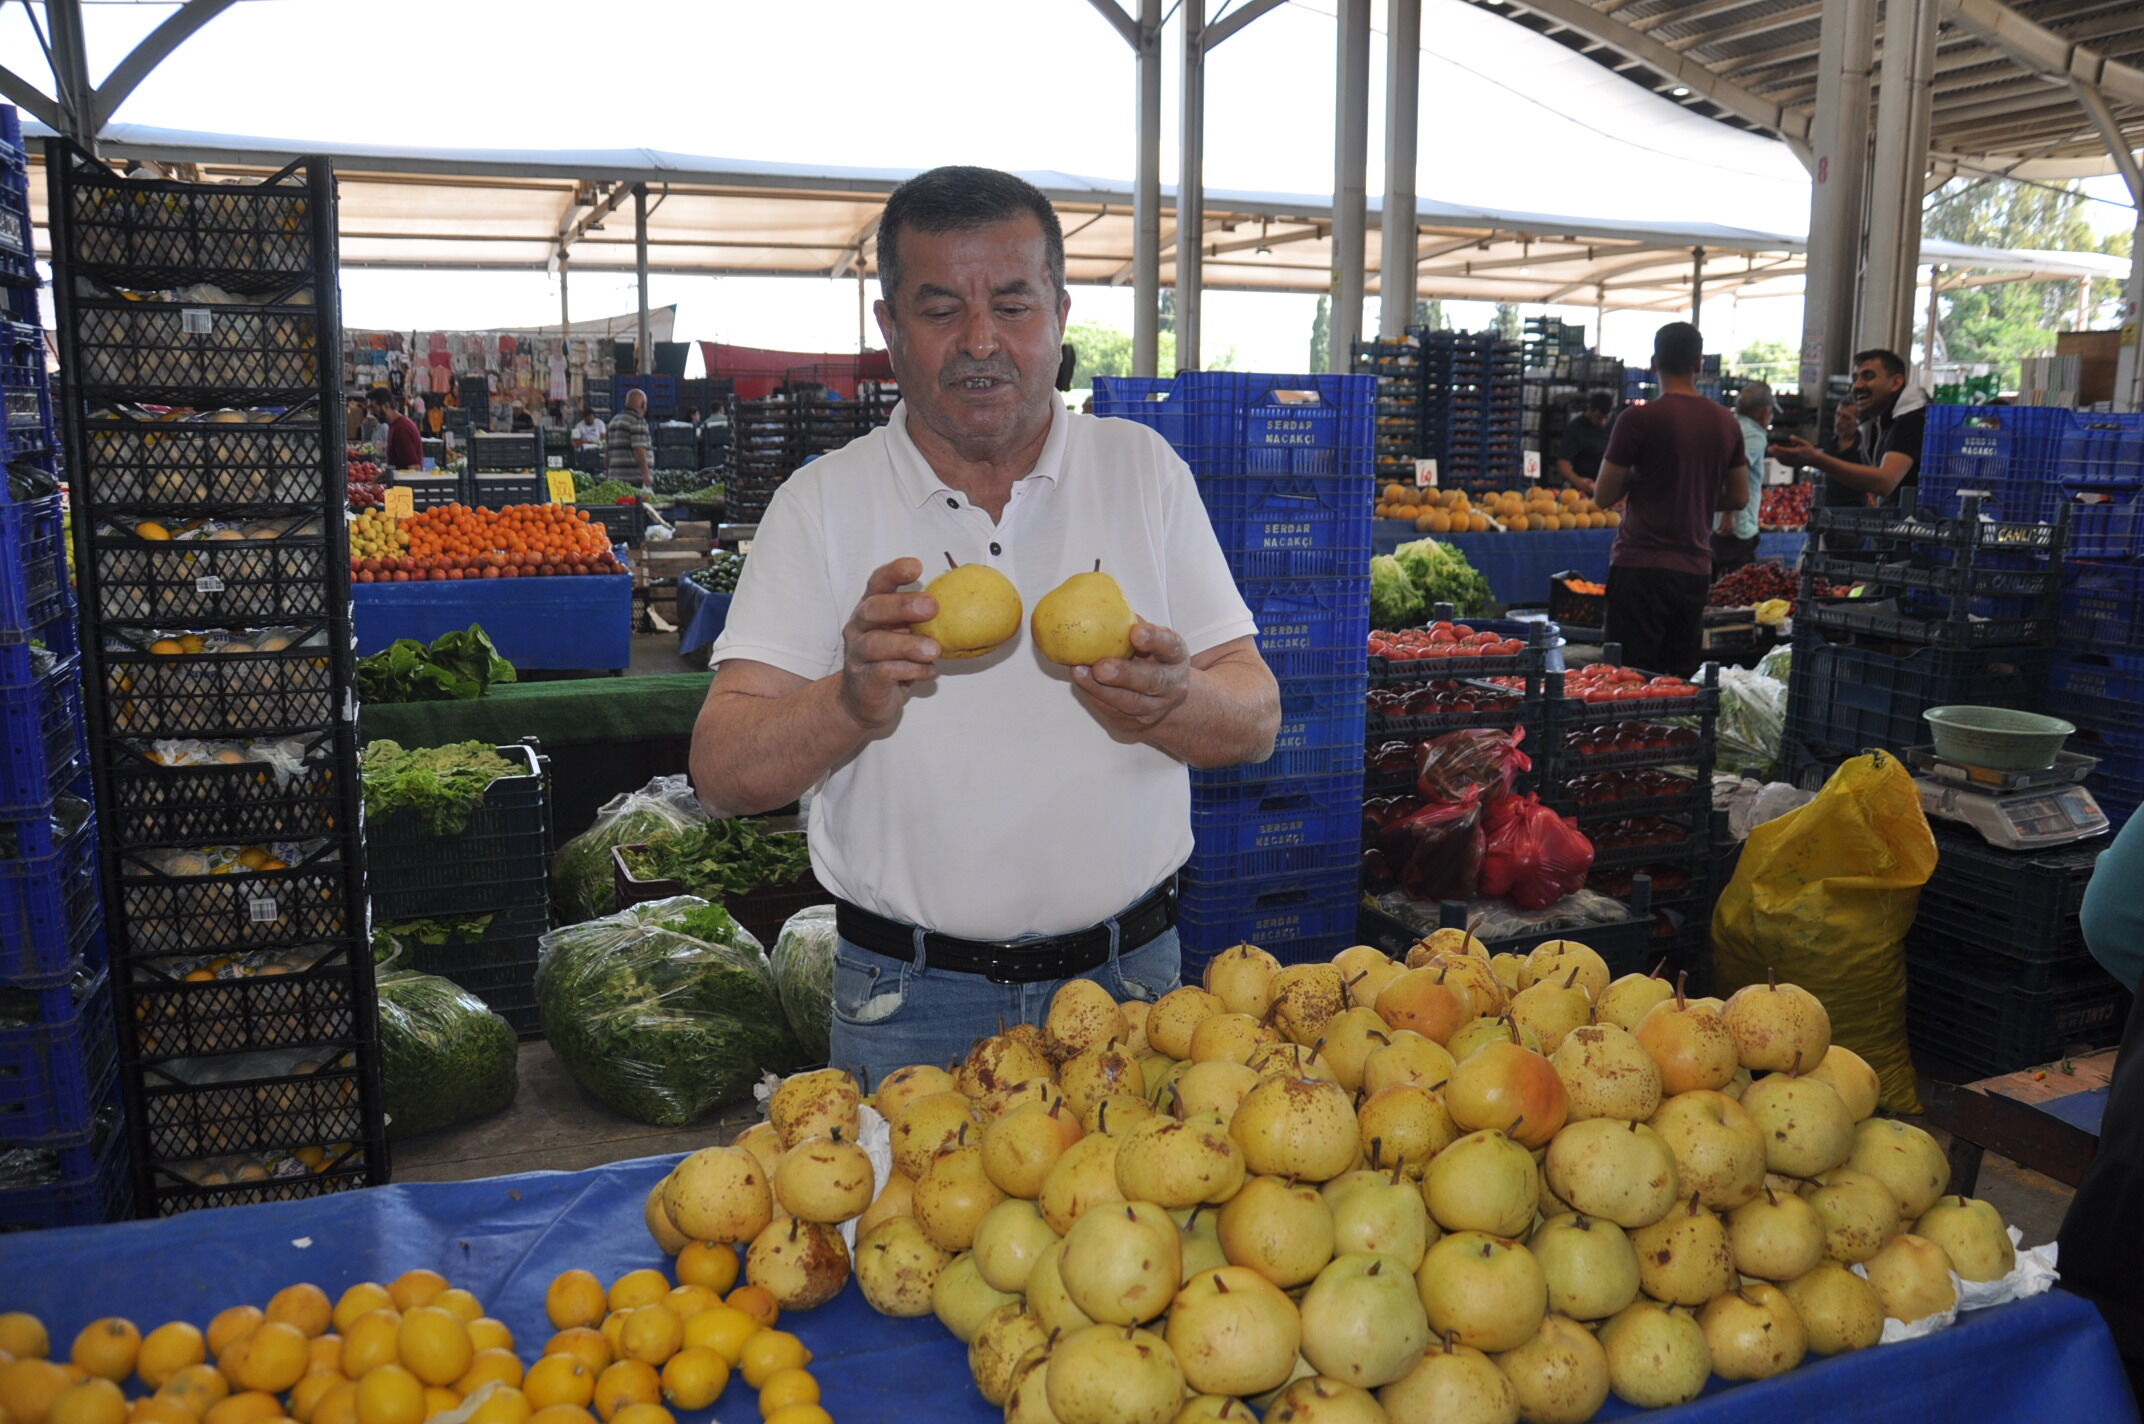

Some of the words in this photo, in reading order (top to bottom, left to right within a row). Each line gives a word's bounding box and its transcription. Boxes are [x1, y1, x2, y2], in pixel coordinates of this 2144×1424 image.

[1266, 420, 1313, 431] SERDAR
[1264, 523, 1311, 534] SERDAR
[1263, 625, 1309, 636] SERDAR
[1259, 820, 1304, 834] SERDAR
